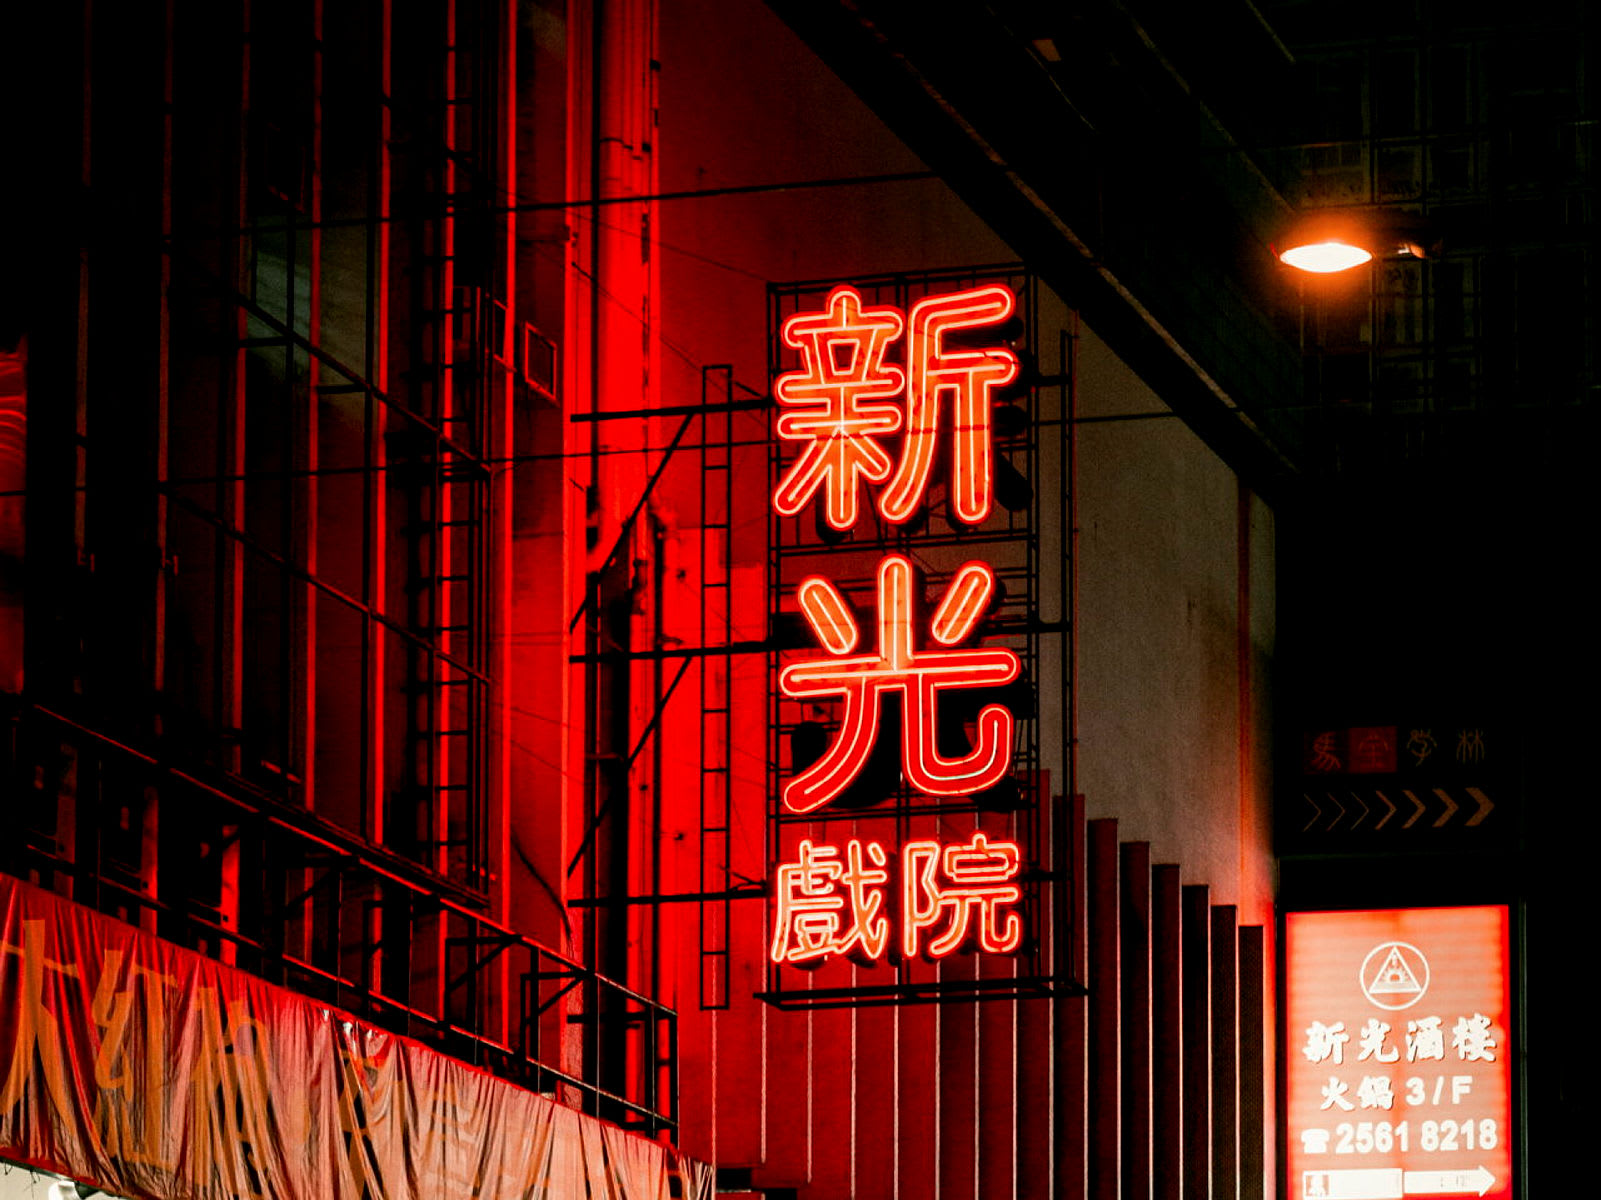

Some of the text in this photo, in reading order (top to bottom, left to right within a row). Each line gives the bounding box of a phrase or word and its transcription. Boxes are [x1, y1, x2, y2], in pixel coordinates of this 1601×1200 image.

[1302, 1014, 1497, 1064] 新光酒樓
[1320, 1076, 1472, 1111] 火鍋 3/F
[1335, 1119, 1498, 1154] 2561 8218
